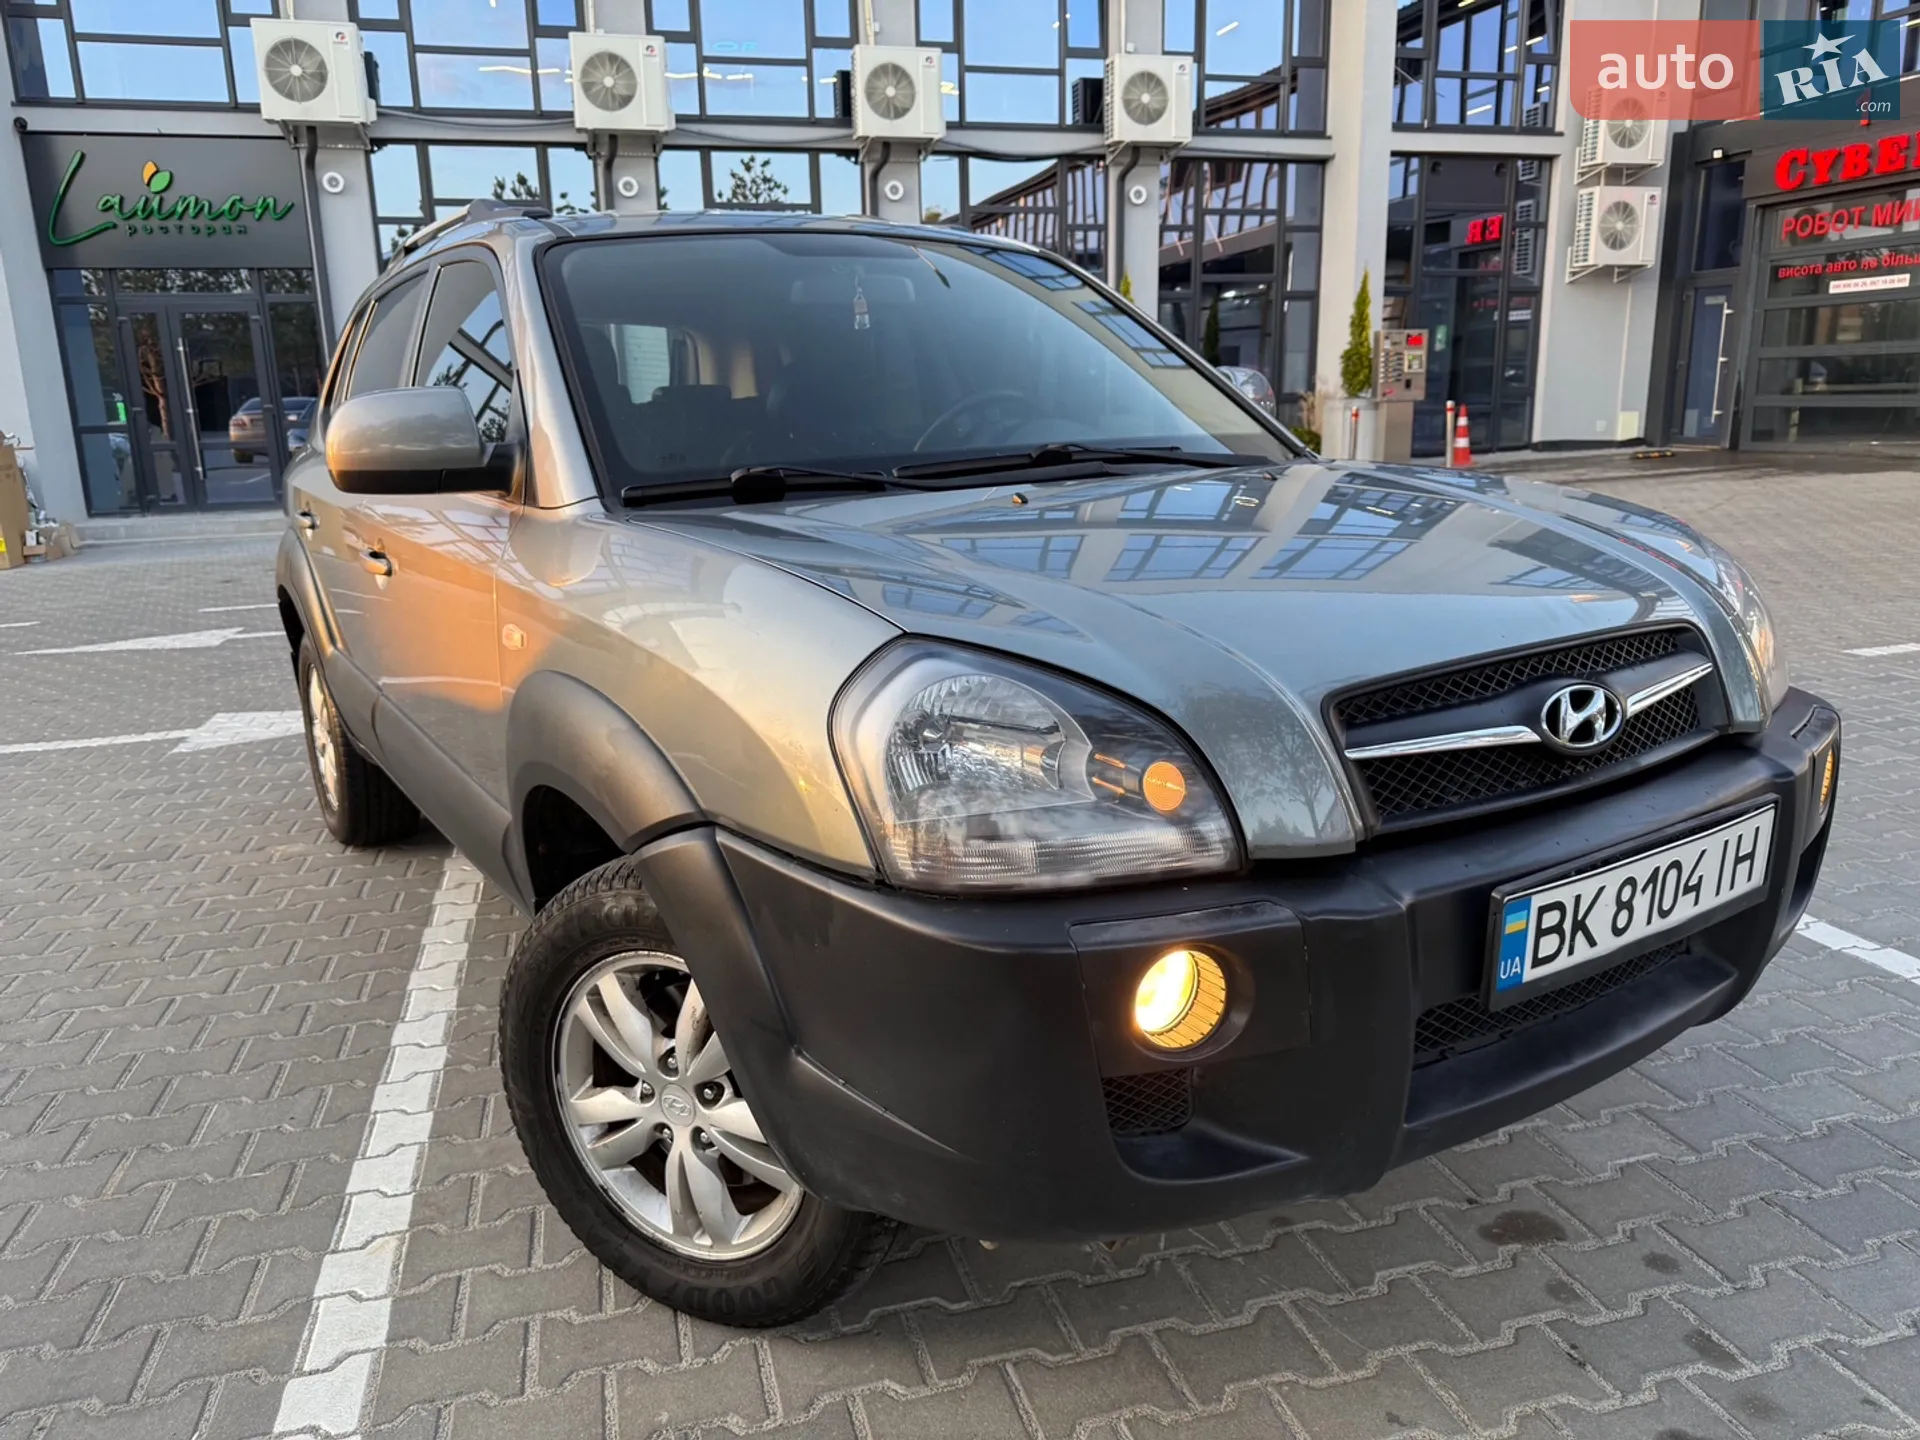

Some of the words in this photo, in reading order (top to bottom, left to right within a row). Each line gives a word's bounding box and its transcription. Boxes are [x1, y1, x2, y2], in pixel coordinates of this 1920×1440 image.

[1781, 206, 1868, 241] РОБОТ
[1778, 264, 1823, 279] висота
[1826, 260, 1858, 274] авто
[1530, 885, 1605, 970] BK
[1611, 847, 1708, 938] 8104
[1714, 825, 1761, 898] IH
[1499, 956, 1522, 980] UA
